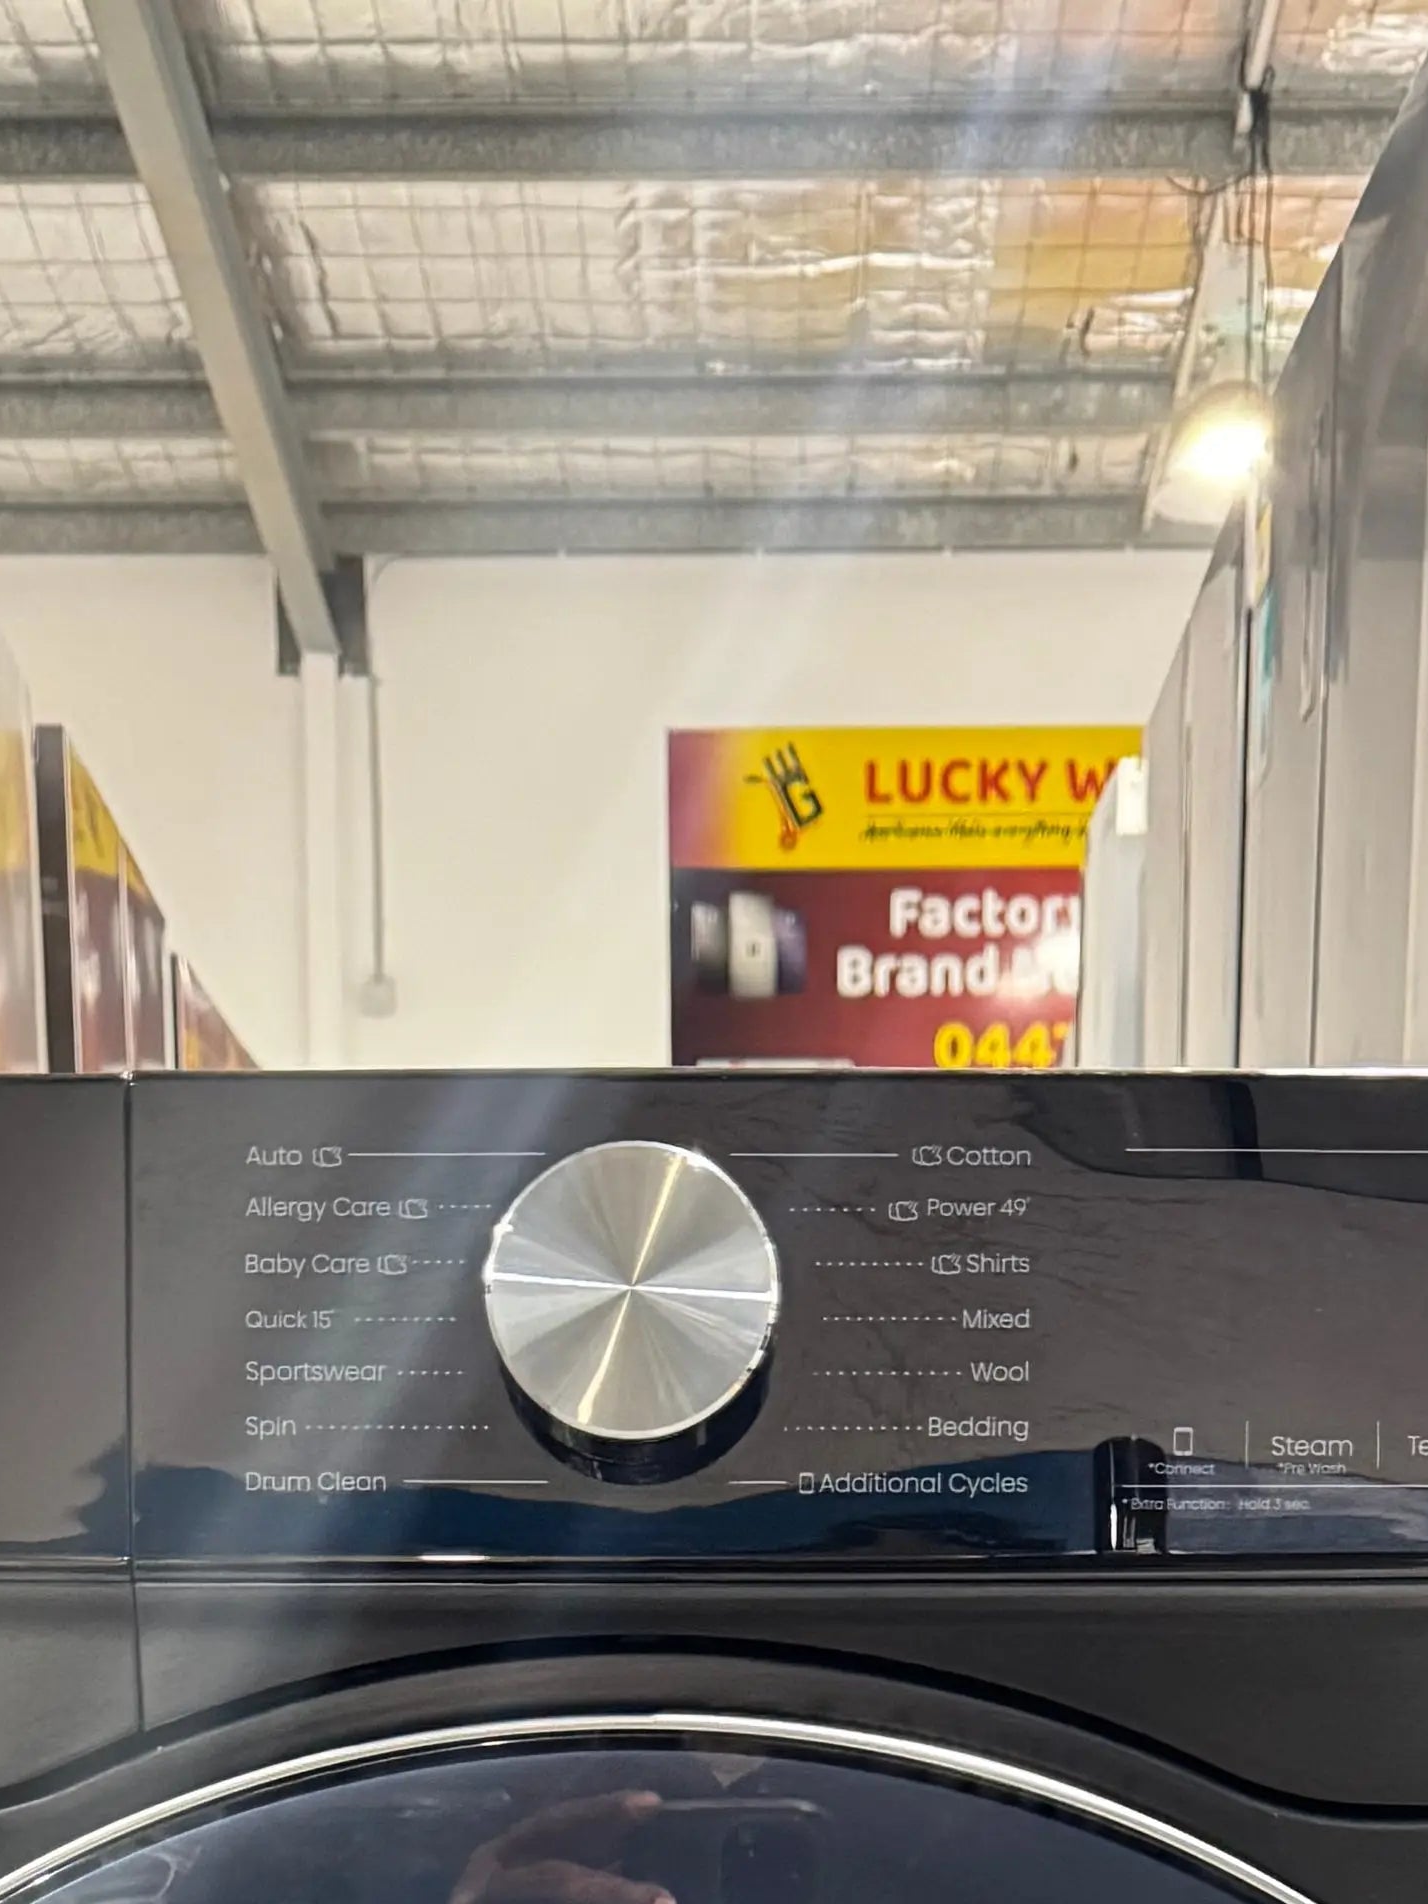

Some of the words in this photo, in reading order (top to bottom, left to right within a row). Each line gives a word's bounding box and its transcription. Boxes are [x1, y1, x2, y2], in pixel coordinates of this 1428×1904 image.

[865, 759, 1048, 804] LUCKY
[837, 945, 1000, 997] Brand
[934, 1021, 1067, 1068] 044
[245, 1146, 303, 1166] Auto
[947, 1146, 1031, 1165] Cotton
[245, 1197, 326, 1222] Allergy
[327, 1198, 391, 1218] Care
[927, 1198, 996, 1216] Power
[245, 1254, 305, 1279] Baby
[308, 1254, 370, 1274] Care
[966, 1254, 1030, 1274] Shirts
[245, 1310, 307, 1328] Quick
[963, 1309, 1030, 1329] Mixed
[245, 1361, 387, 1386] Sportswear
[970, 1362, 1029, 1382] Wool
[245, 1416, 297, 1439] Spin
[927, 1416, 1029, 1441] Bedding
[1272, 1436, 1353, 1456] Steam
[1308, 1463, 1346, 1473] Wash
[245, 1472, 311, 1491] Drum
[318, 1471, 387, 1491] Clean
[819, 1473, 942, 1493] Additional
[948, 1472, 1028, 1498] Cycles
[1131, 1498, 1164, 1510] Extra
[1238, 1499, 1270, 1510] Hold
[1273, 1499, 1281, 1510] 3
